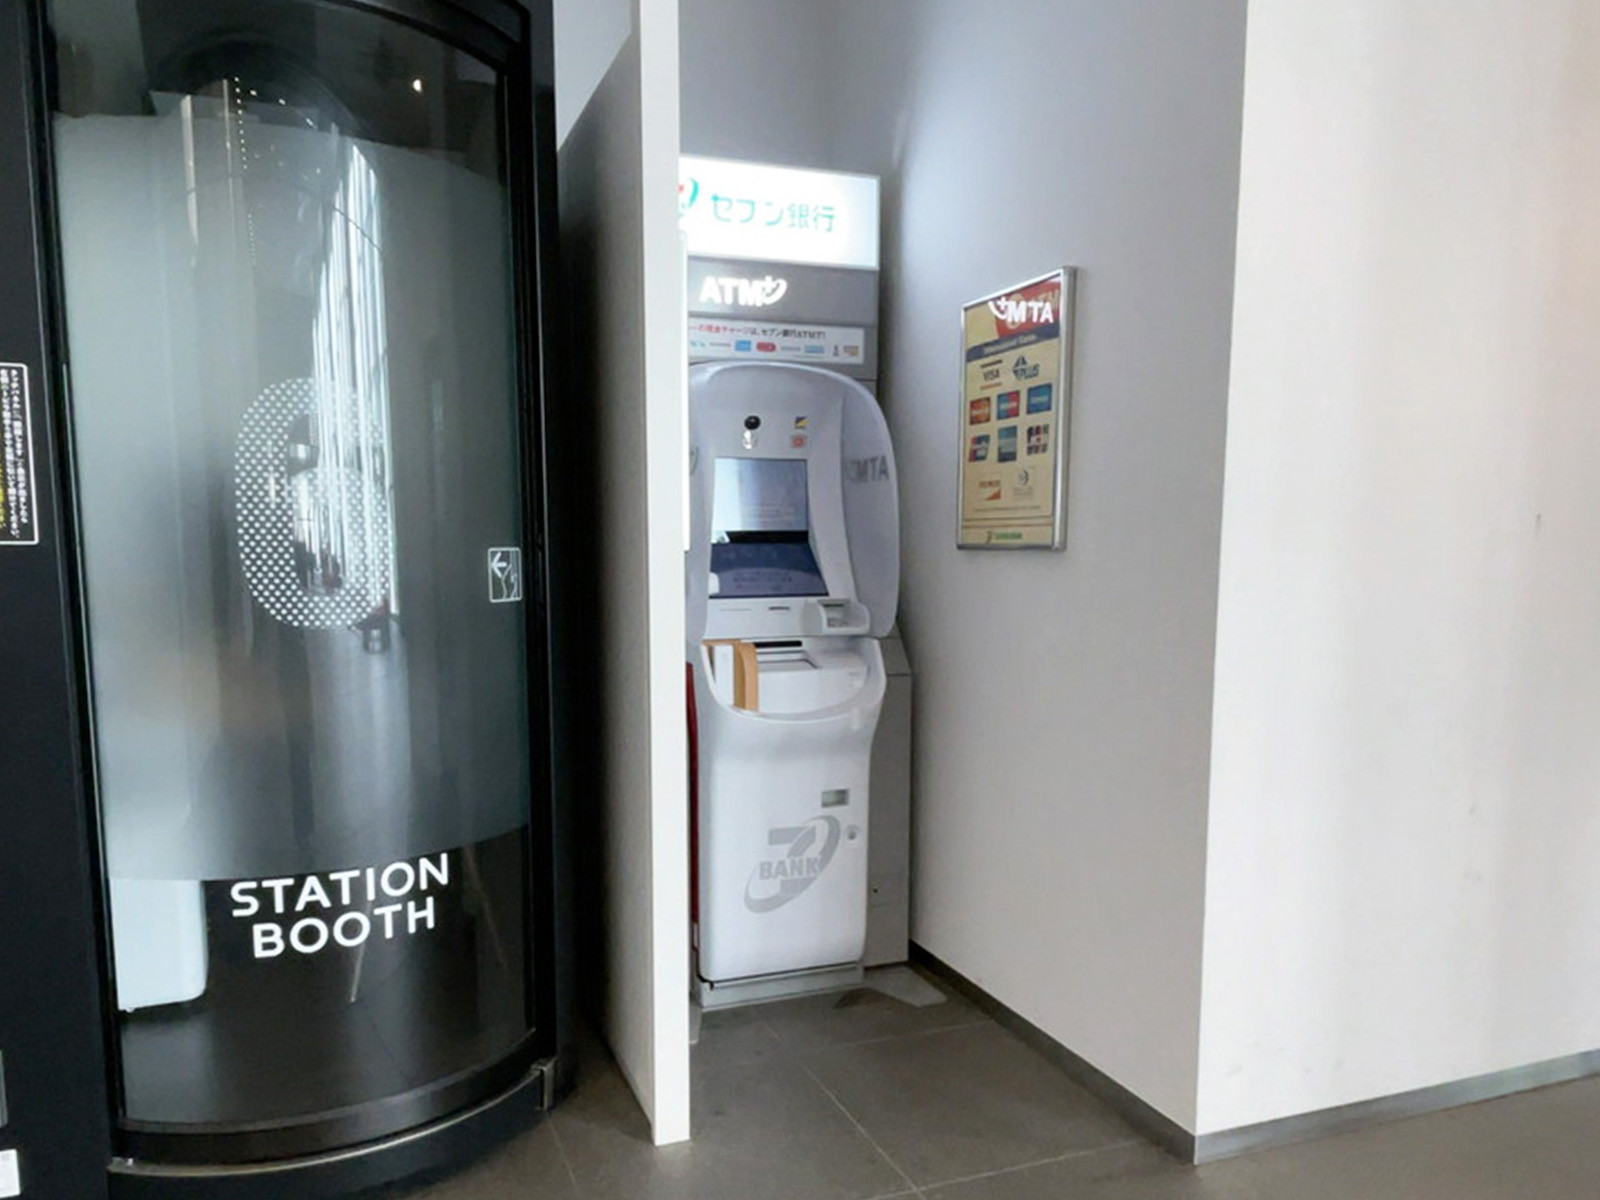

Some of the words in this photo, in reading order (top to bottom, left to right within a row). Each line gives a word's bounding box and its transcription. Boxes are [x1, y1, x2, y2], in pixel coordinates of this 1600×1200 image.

[699, 276, 762, 306] ATM
[230, 852, 449, 917] STATION
[759, 857, 820, 880] BANK
[252, 896, 435, 958] BOOTH
